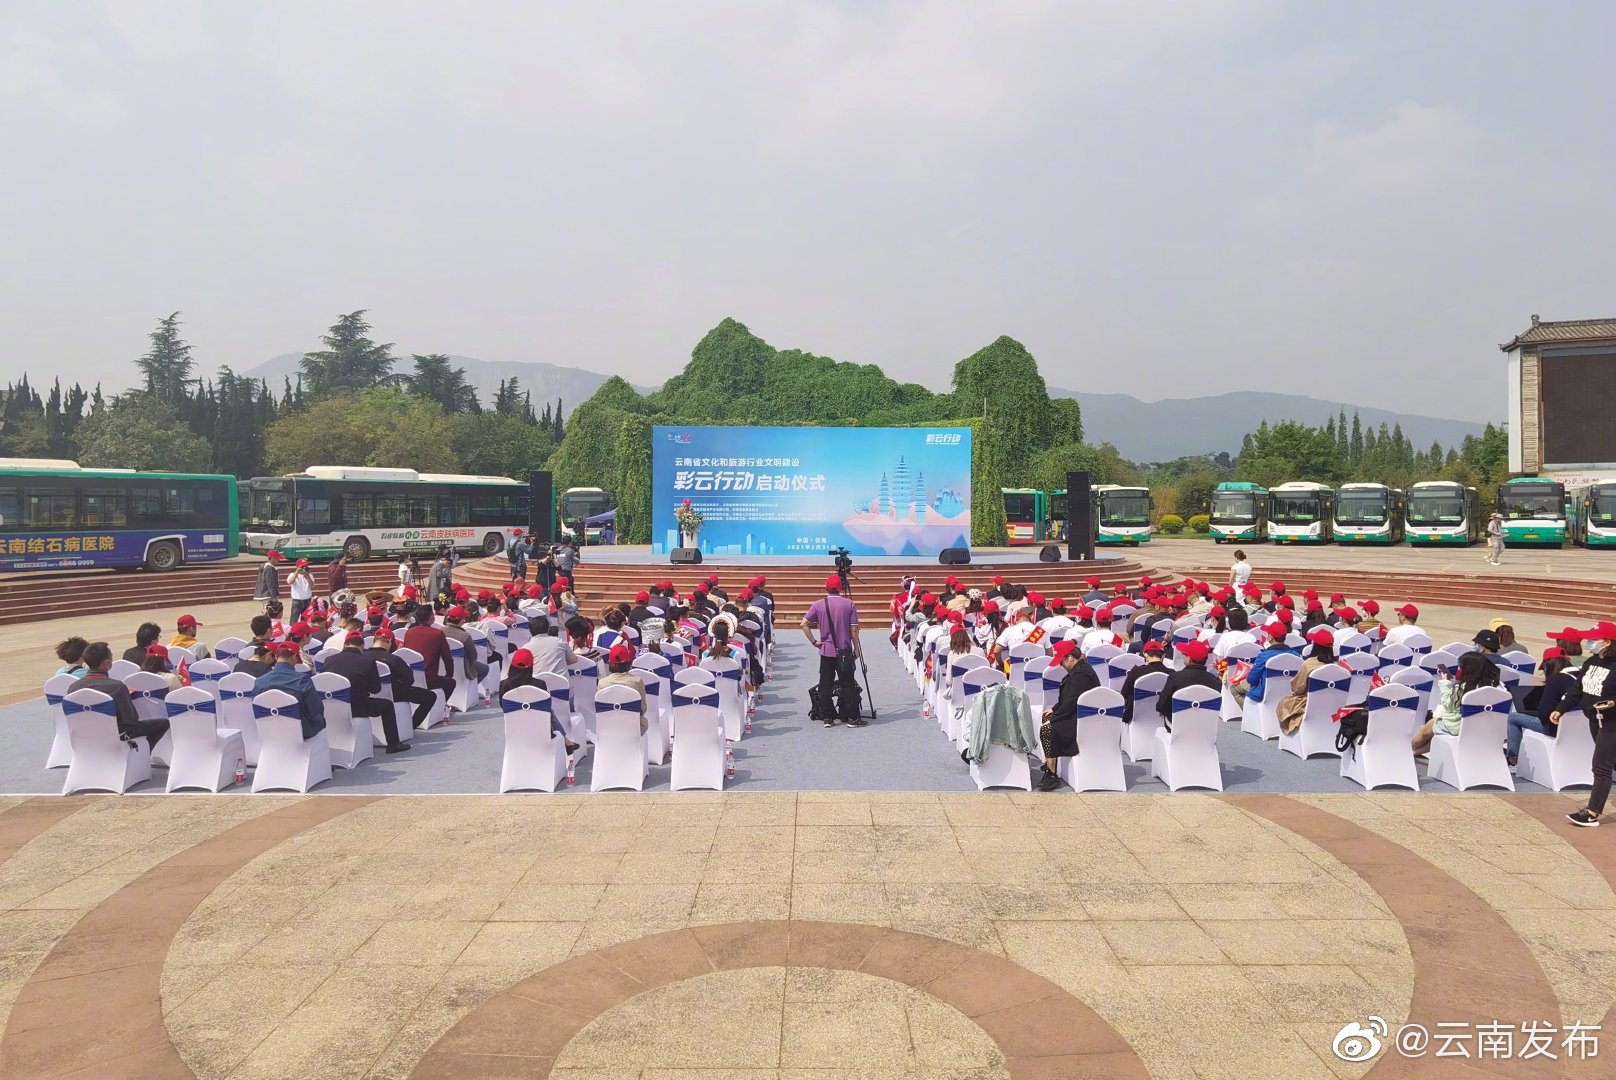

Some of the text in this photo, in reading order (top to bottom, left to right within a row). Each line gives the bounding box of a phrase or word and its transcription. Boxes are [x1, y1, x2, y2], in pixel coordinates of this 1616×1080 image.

[675, 457, 801, 467] 云南省文化和旅游行业文明建设
